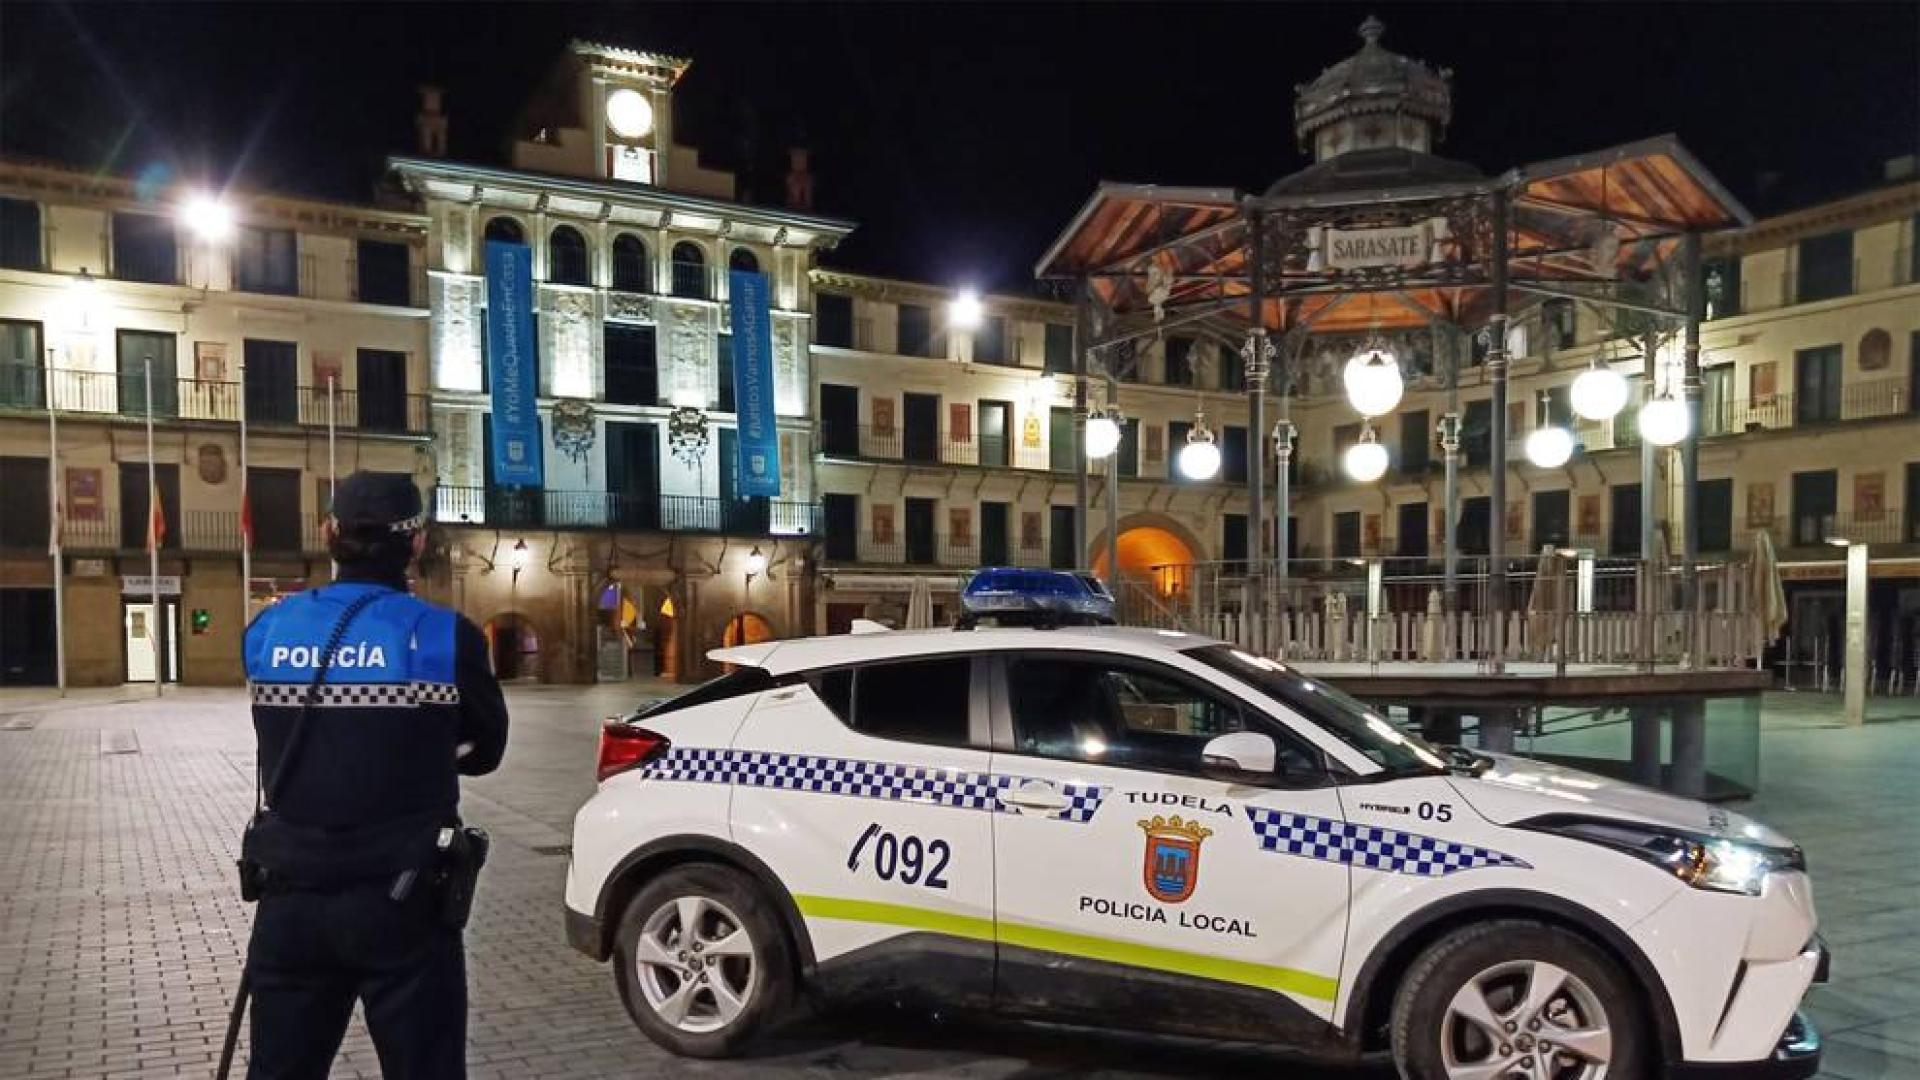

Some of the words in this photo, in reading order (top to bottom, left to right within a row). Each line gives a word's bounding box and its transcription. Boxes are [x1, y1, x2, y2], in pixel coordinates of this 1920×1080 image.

[1333, 234, 1418, 260] SARASATE
[1124, 792, 1233, 817] TUDELA
[1418, 801, 1452, 822] 05
[874, 832, 950, 889] 092
[1079, 896, 1167, 924] POLICIA
[1179, 911, 1257, 938] LOCAL
